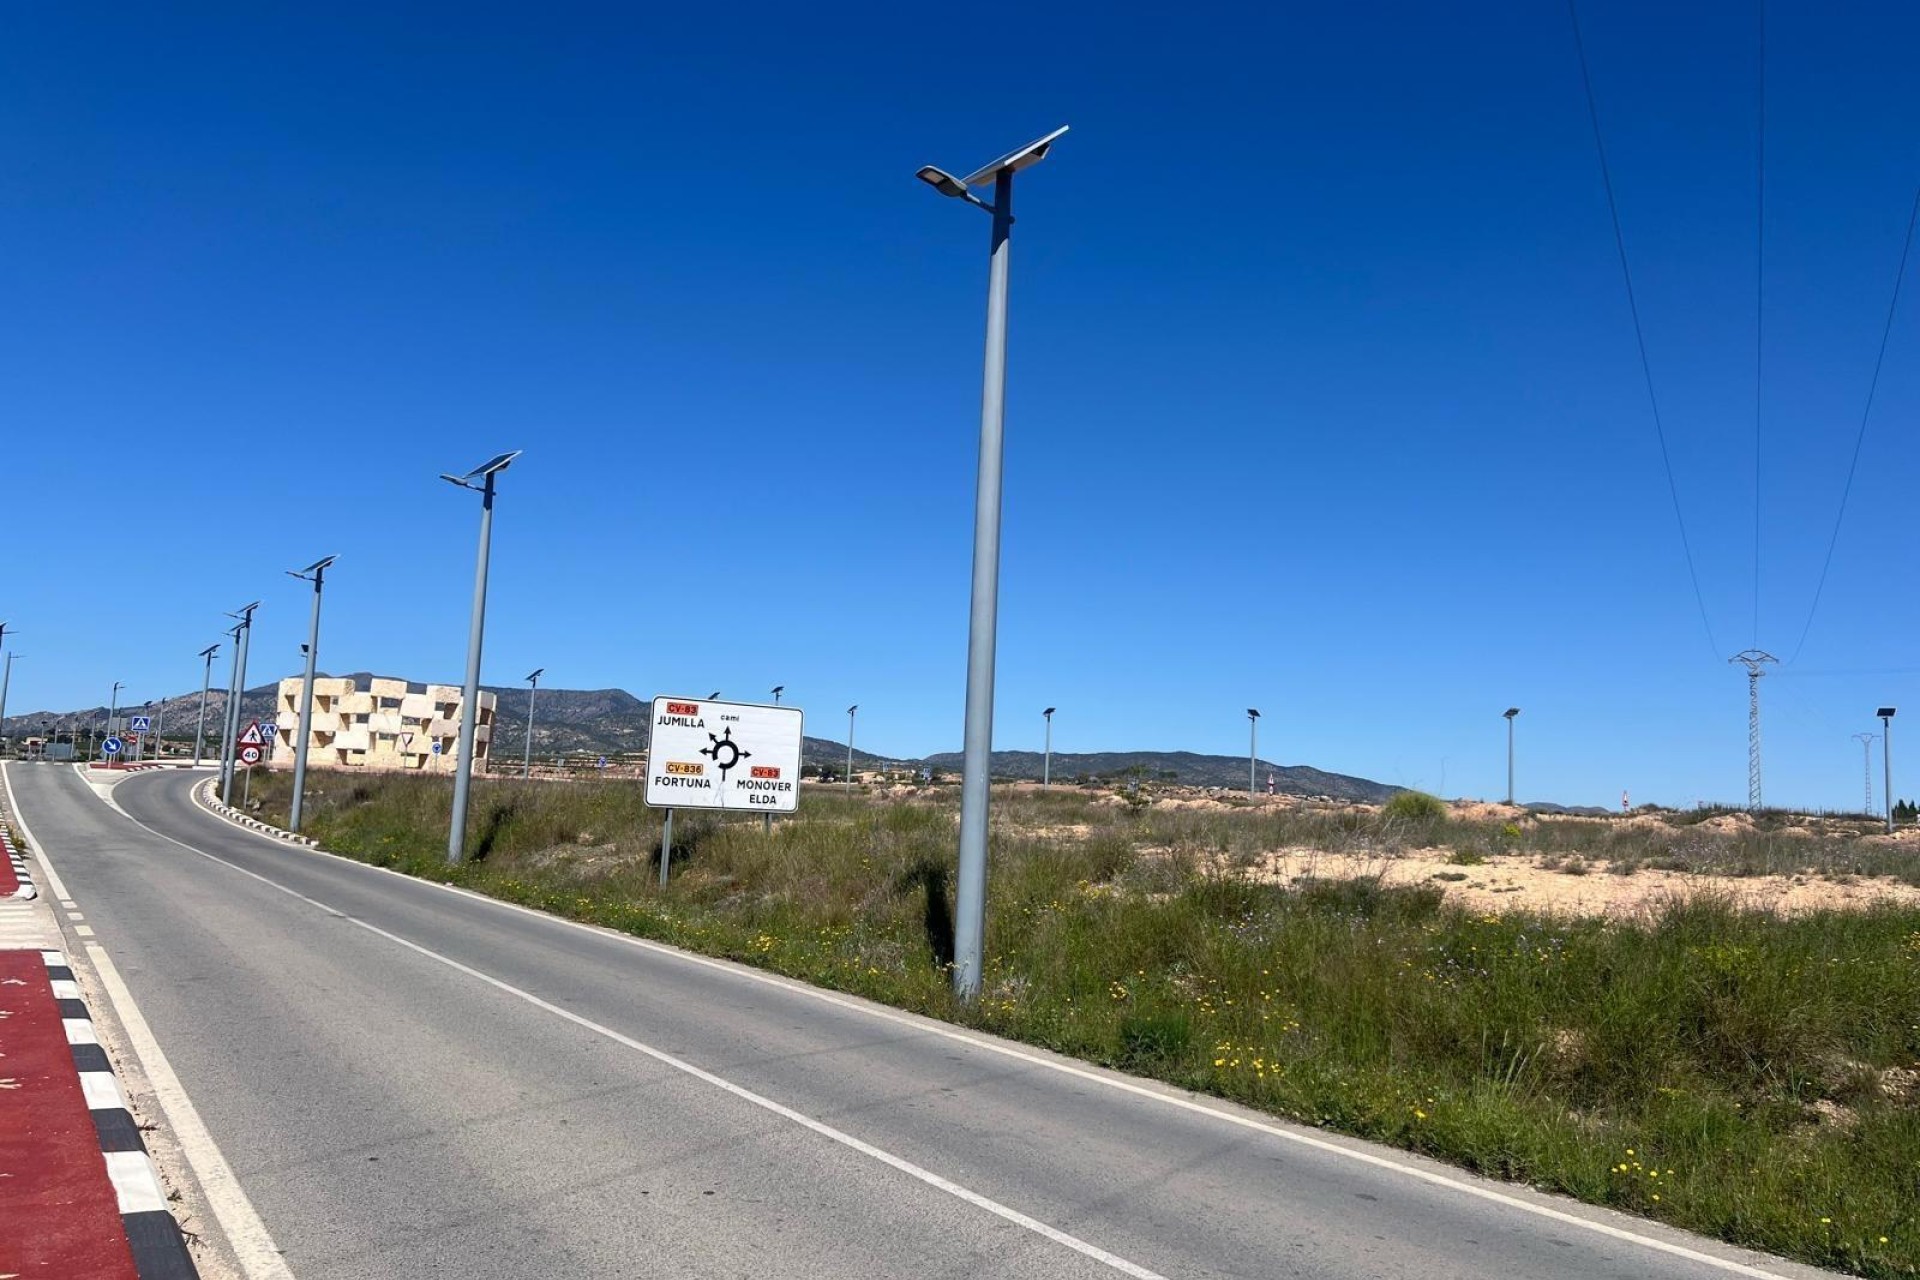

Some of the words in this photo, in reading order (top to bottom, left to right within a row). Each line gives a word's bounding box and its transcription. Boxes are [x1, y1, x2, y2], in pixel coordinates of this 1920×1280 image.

[668, 704, 697, 714] CV-83
[658, 716, 705, 728] JUMILLA
[667, 764, 702, 774] CV-836
[752, 768, 779, 777] CV-83
[655, 777, 711, 788] FORTUNA
[750, 794, 776, 804] ELDA
